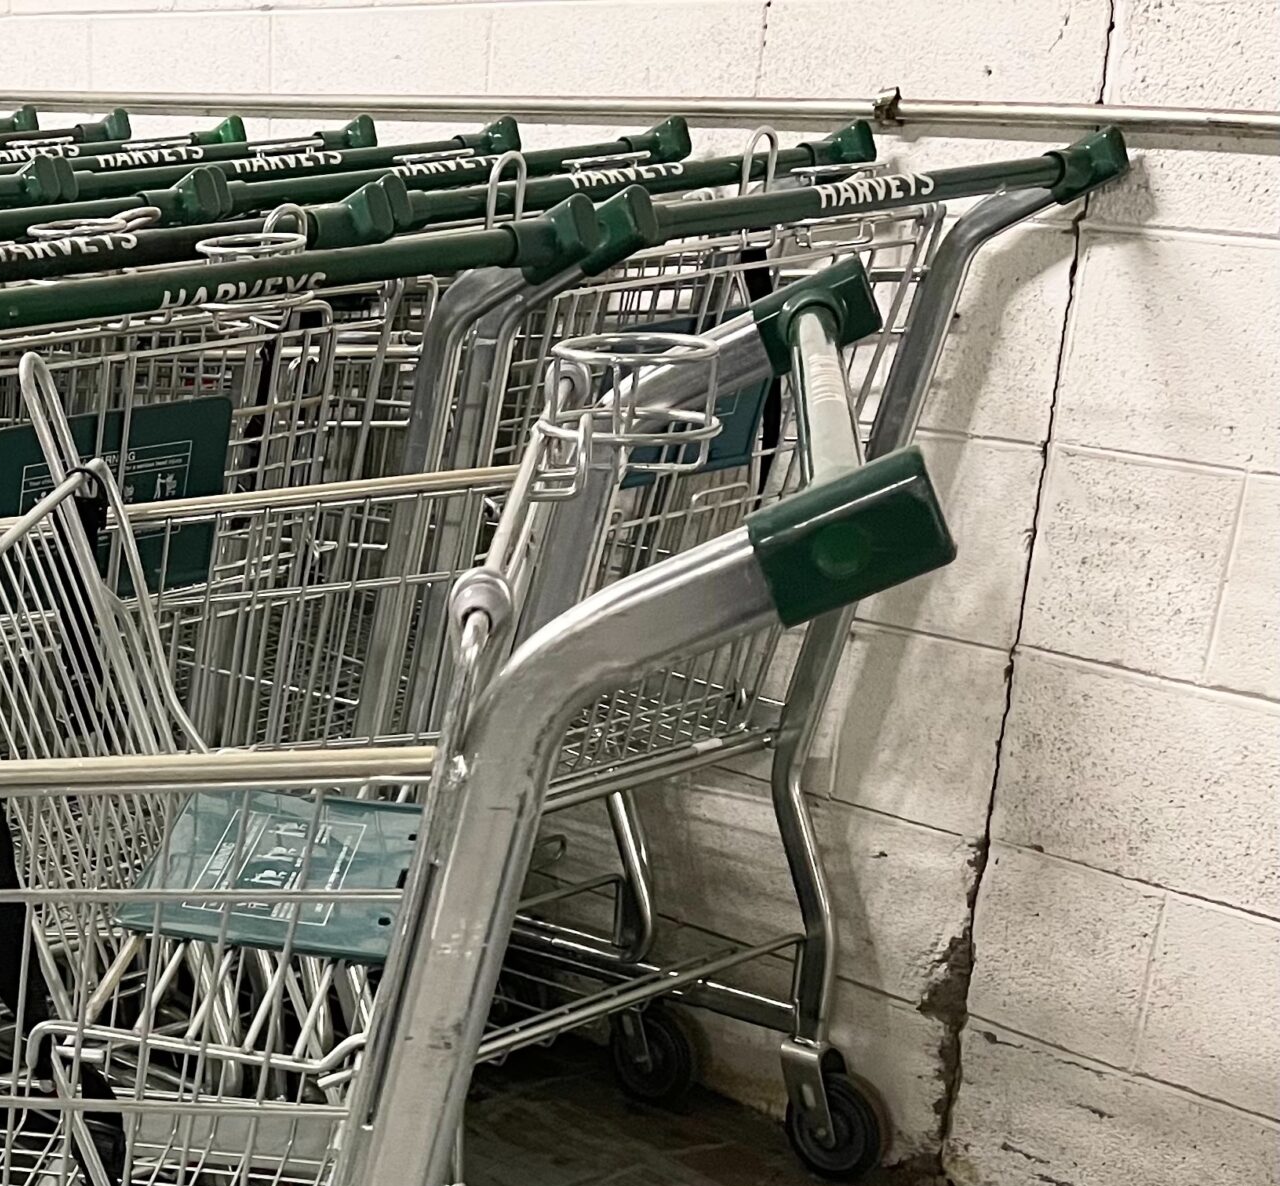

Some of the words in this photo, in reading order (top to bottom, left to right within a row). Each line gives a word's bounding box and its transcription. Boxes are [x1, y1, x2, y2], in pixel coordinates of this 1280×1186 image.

[96, 147, 205, 169] HARVEYS
[231, 151, 342, 174] HARVEYS
[567, 162, 684, 187] HARVEYS
[813, 173, 935, 209] HARVEYS
